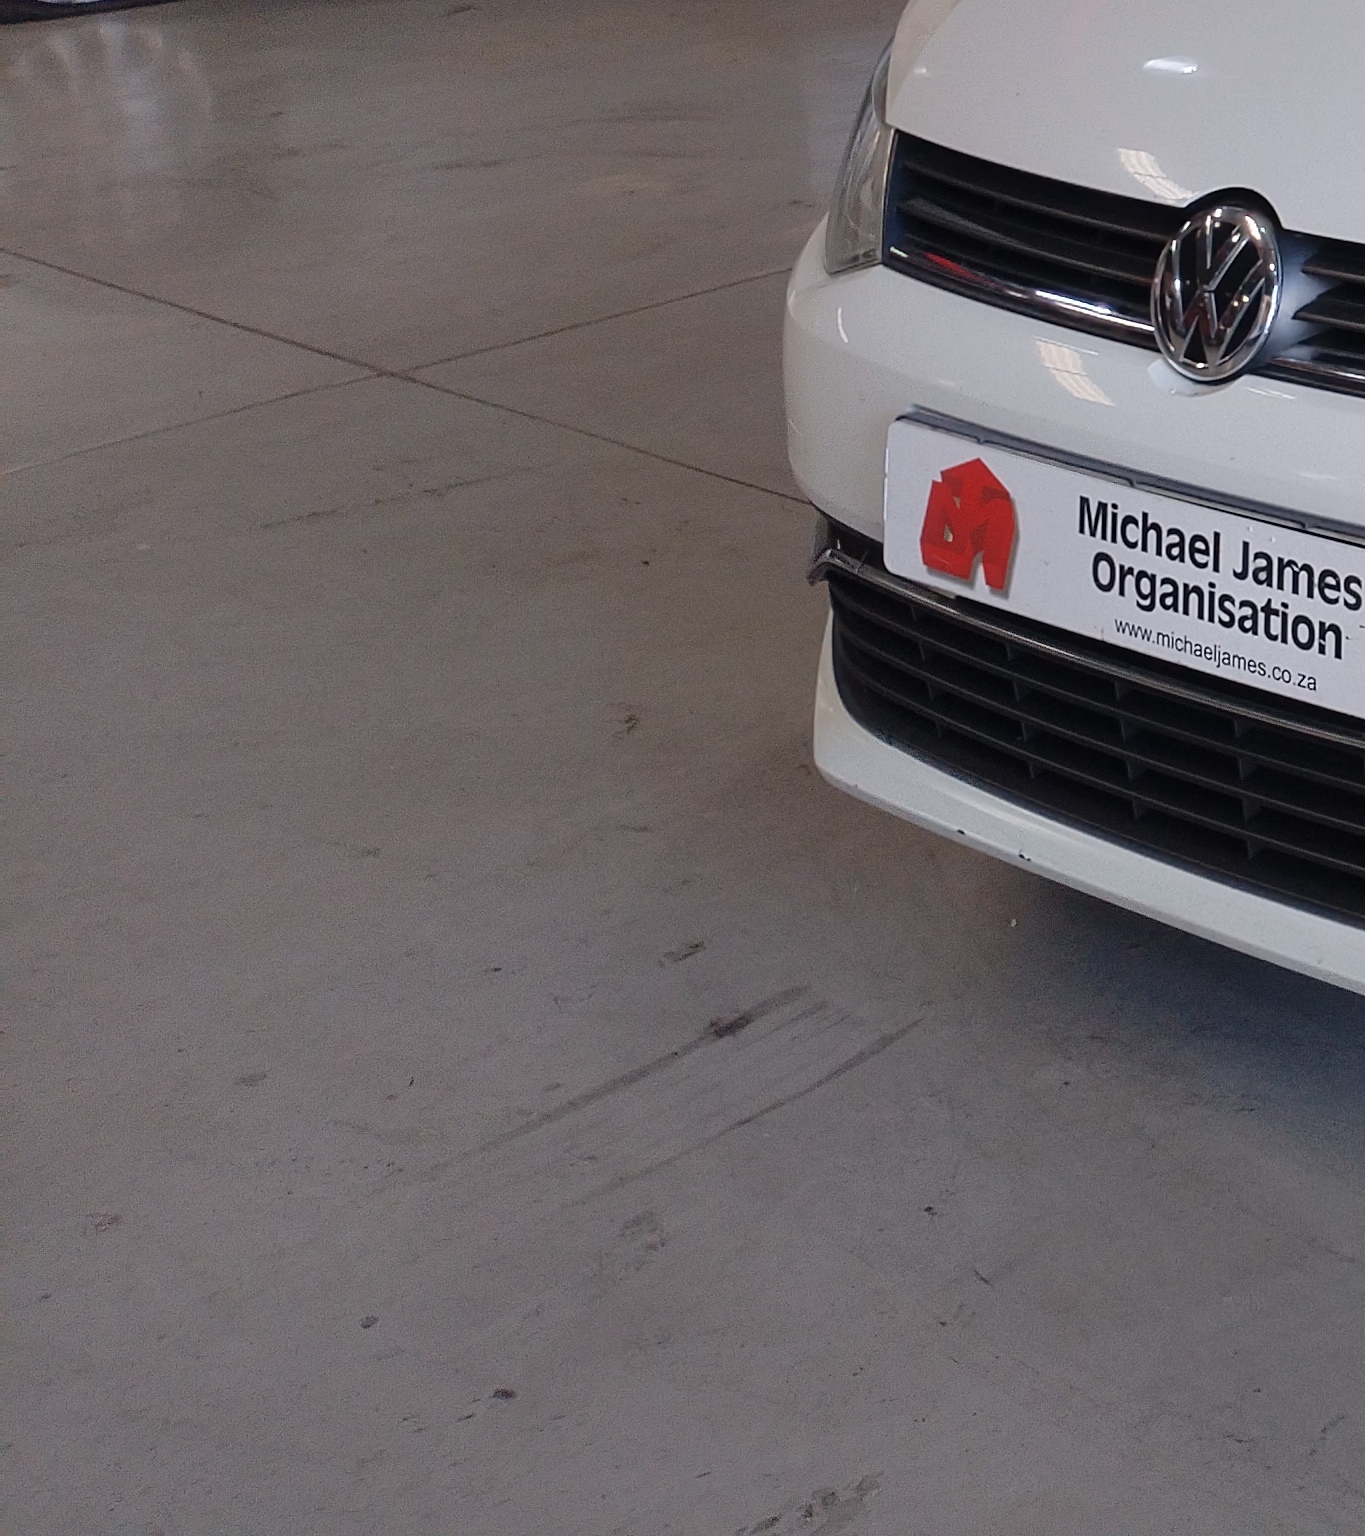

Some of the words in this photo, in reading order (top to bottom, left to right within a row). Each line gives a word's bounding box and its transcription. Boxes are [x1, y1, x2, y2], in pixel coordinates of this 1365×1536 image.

[1078, 495, 1221, 573] Michael
[1232, 540, 1363, 612] James
[1092, 551, 1343, 660] Organisation
[1114, 618, 1317, 692] www.michaeljames.co.za
